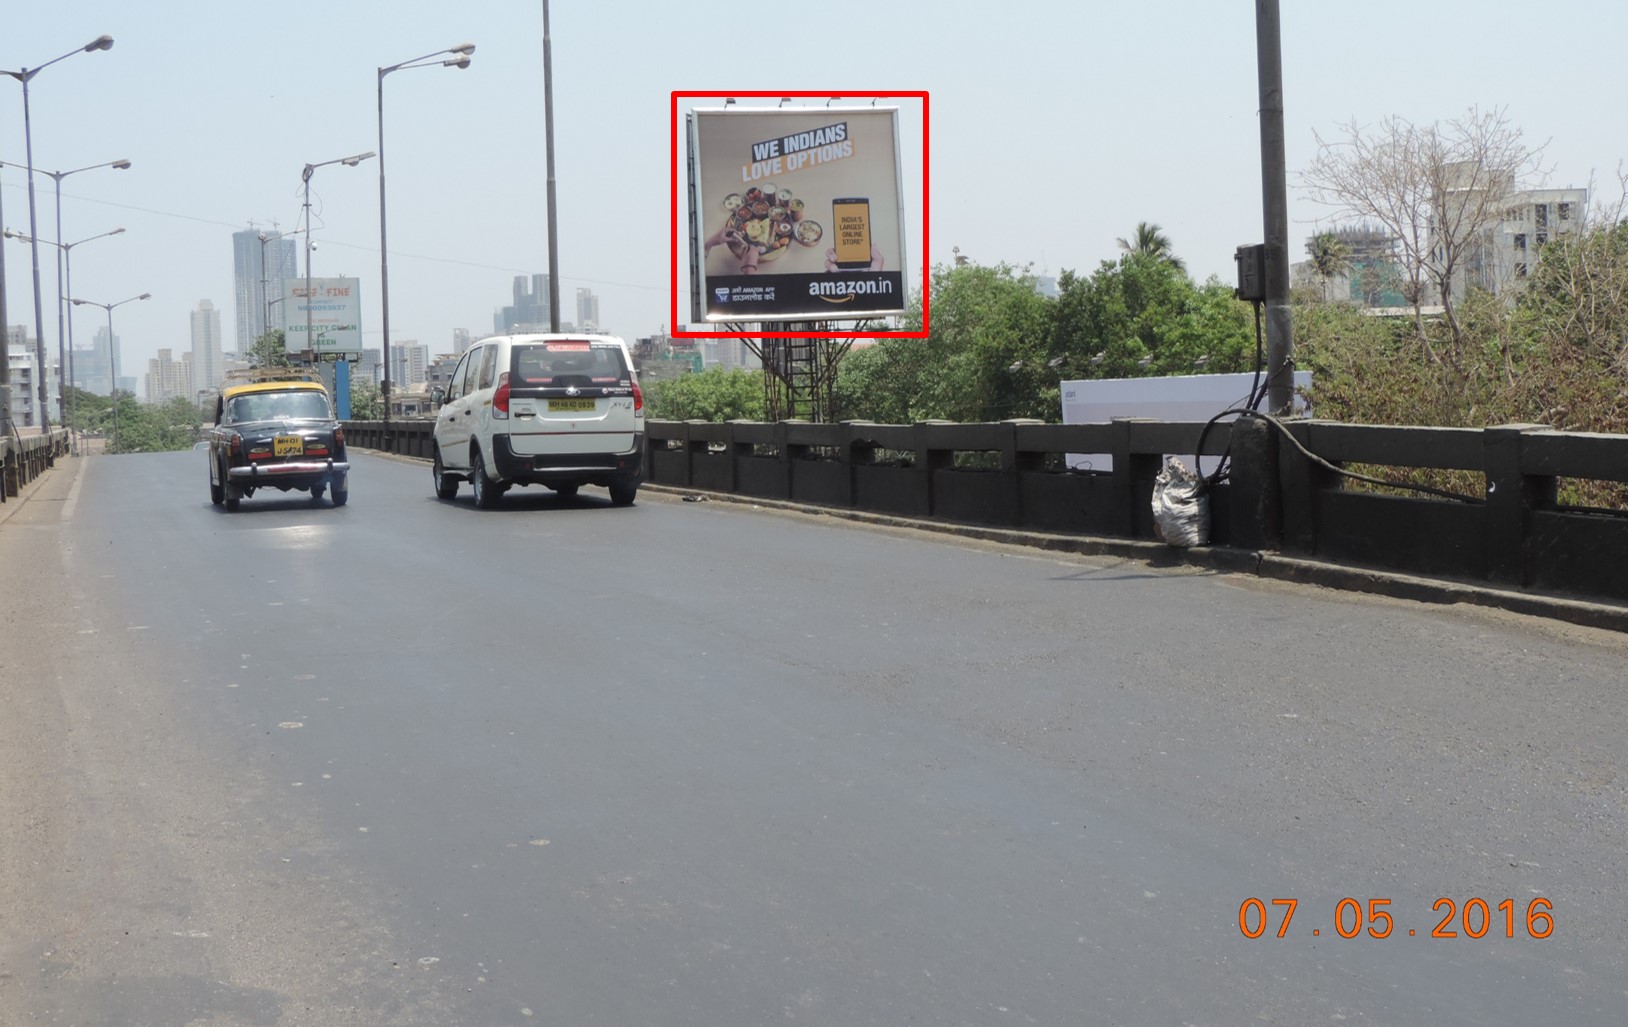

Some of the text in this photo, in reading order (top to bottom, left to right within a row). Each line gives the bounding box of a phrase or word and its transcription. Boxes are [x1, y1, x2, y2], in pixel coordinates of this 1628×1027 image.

[753, 123, 847, 161] WE INDIANS
[742, 140, 853, 183] LOVE OPTIONS
[839, 223, 865, 231] LARGEST
[842, 230, 863, 238] ONLINE
[809, 277, 892, 295] amazon.in
